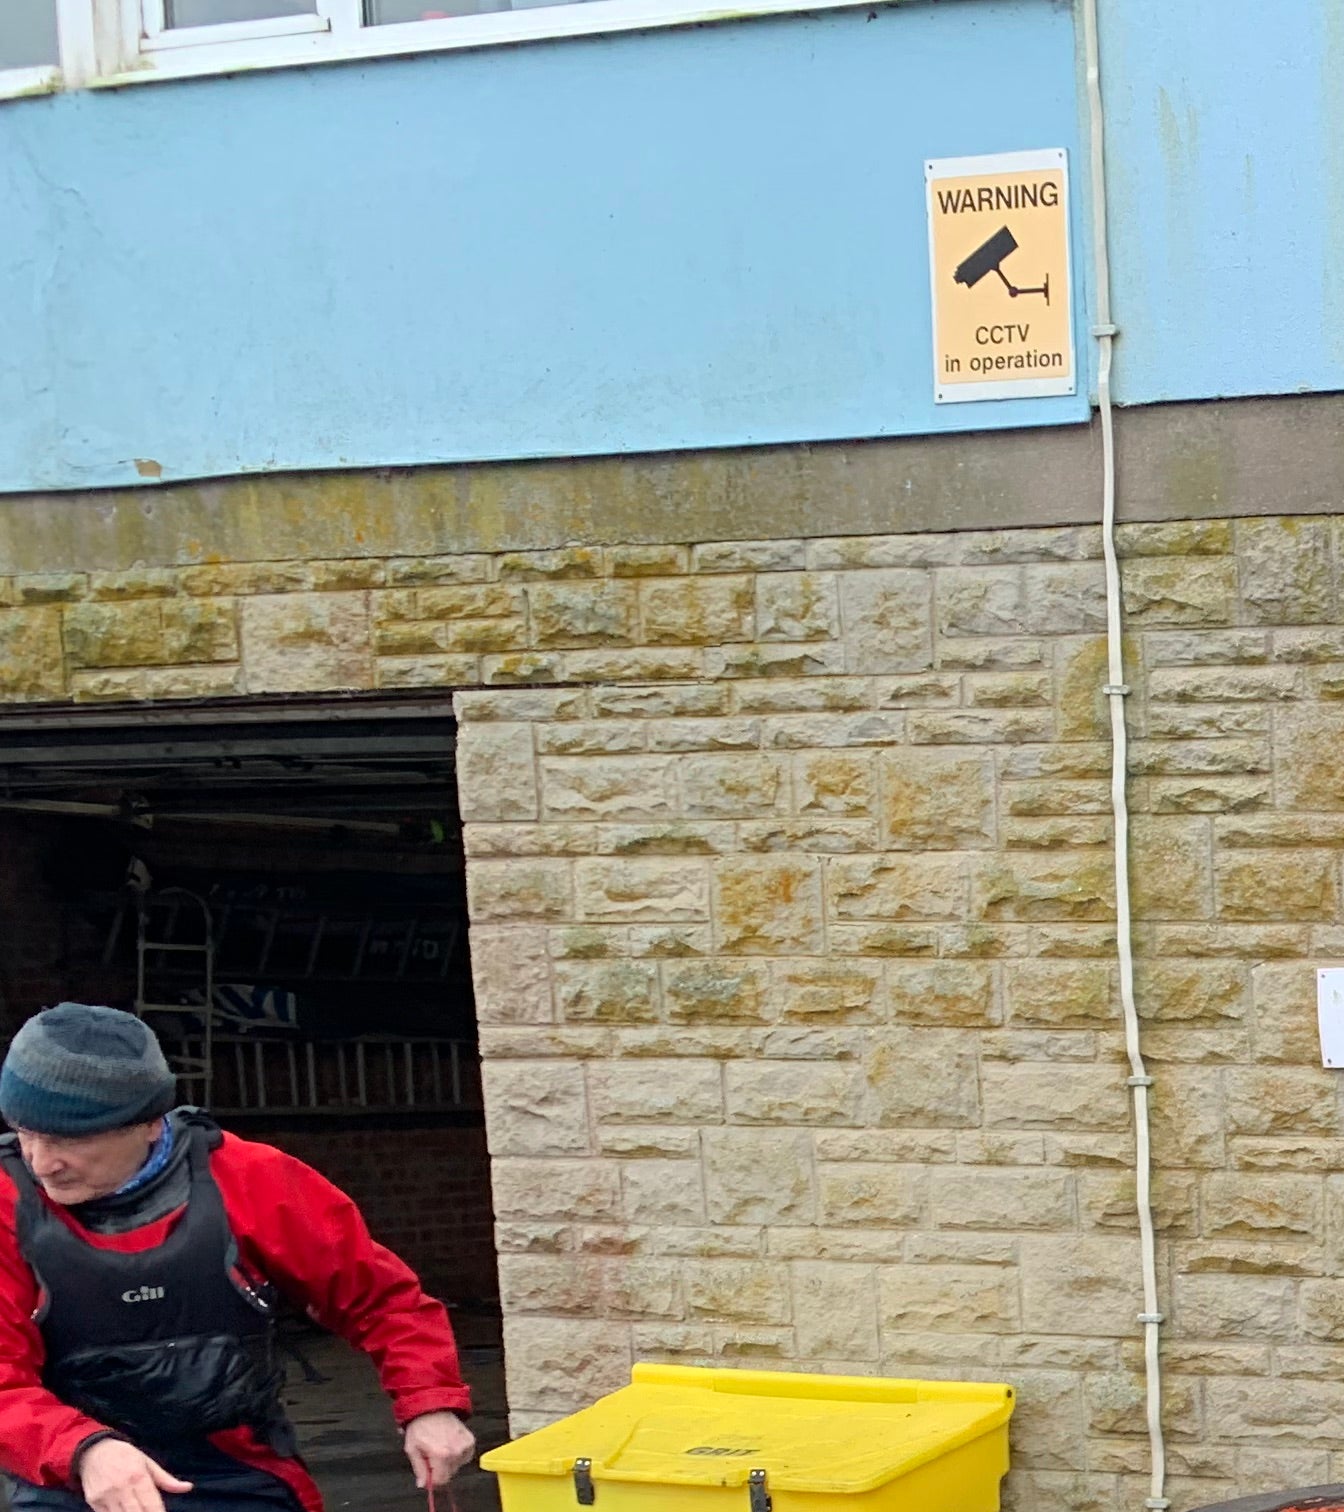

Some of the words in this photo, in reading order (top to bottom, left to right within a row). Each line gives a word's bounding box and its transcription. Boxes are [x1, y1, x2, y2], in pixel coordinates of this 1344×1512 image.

[937, 181, 1059, 214] WARNING
[975, 324, 1030, 345] CCTV
[945, 354, 961, 373] in
[969, 350, 1063, 374] operation
[121, 1285, 165, 1303] Gill
[685, 1446, 761, 1456] GRIT
